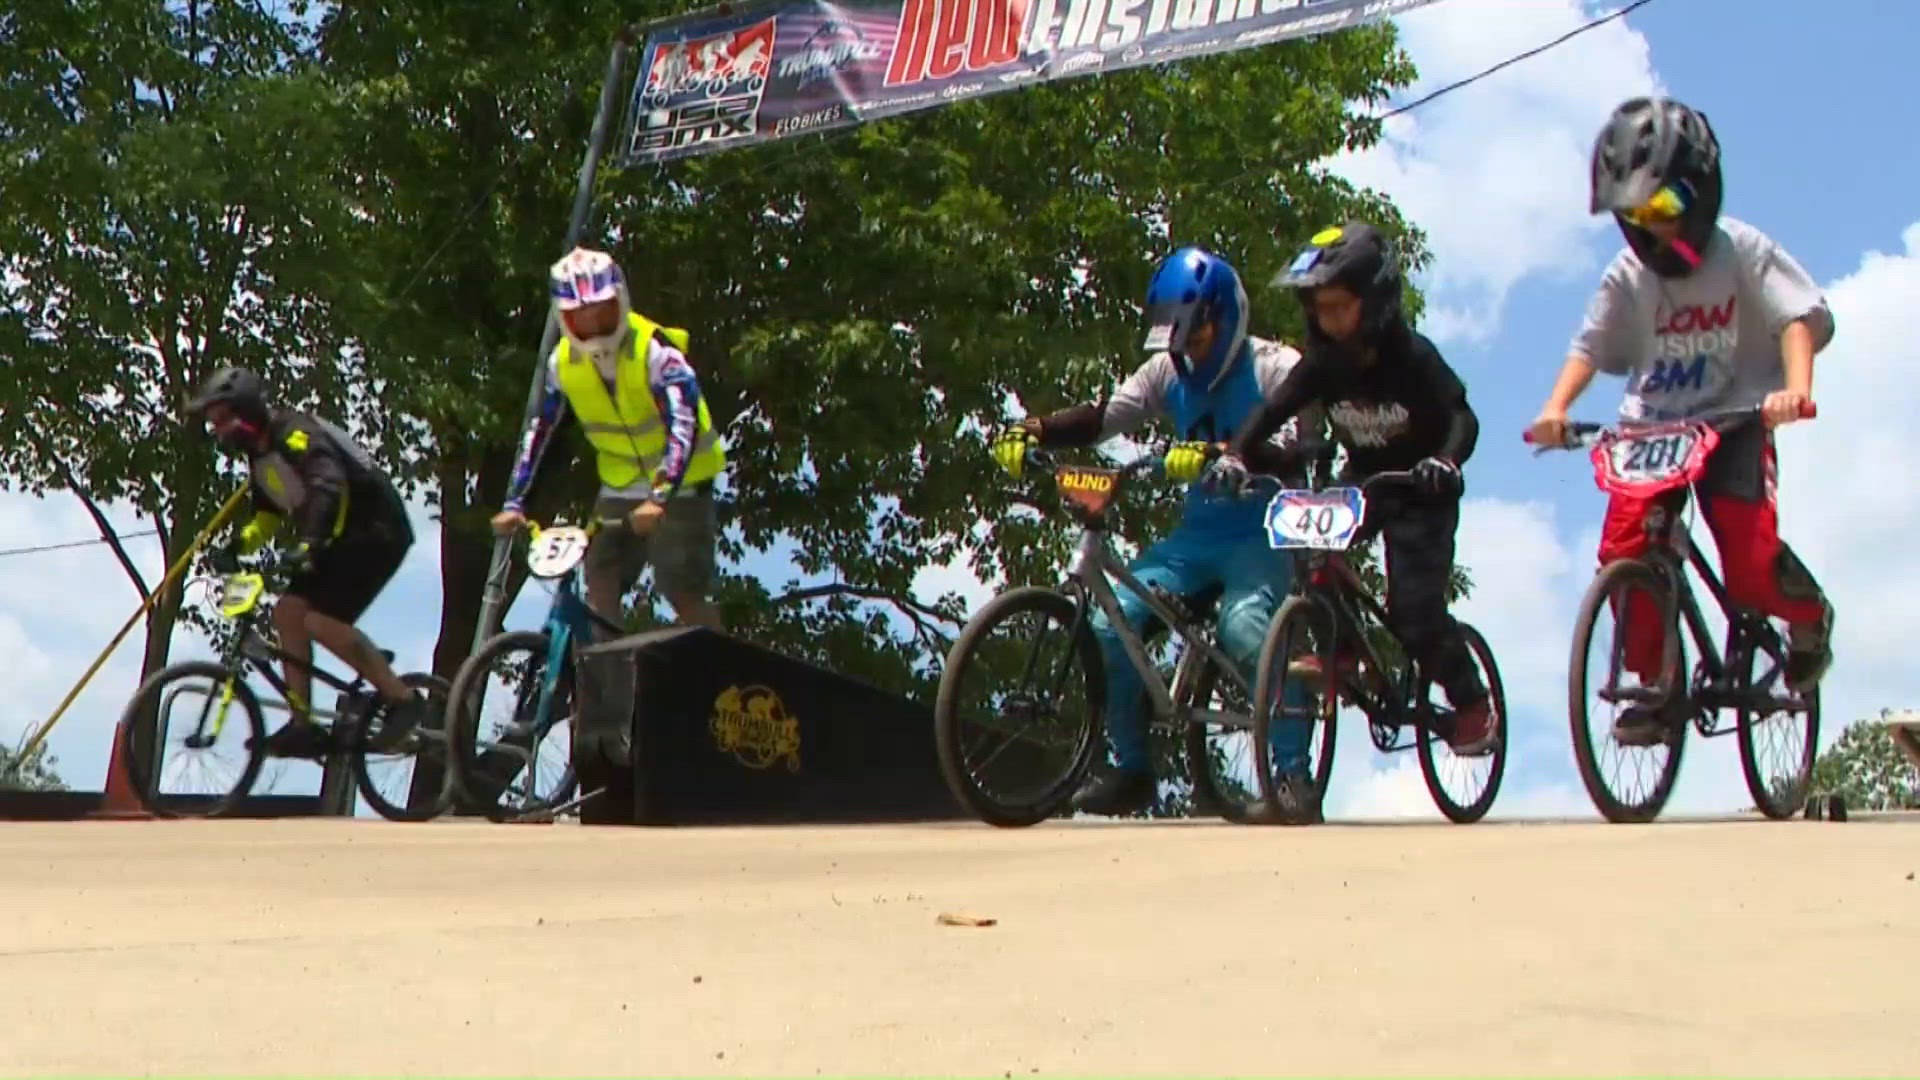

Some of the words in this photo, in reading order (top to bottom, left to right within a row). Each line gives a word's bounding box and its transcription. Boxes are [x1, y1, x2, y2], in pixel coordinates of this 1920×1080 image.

[1655, 295, 1736, 337] LOW
[1624, 435, 1682, 471] 201
[1063, 471, 1112, 492] BLIND
[1295, 507, 1335, 536] 40
